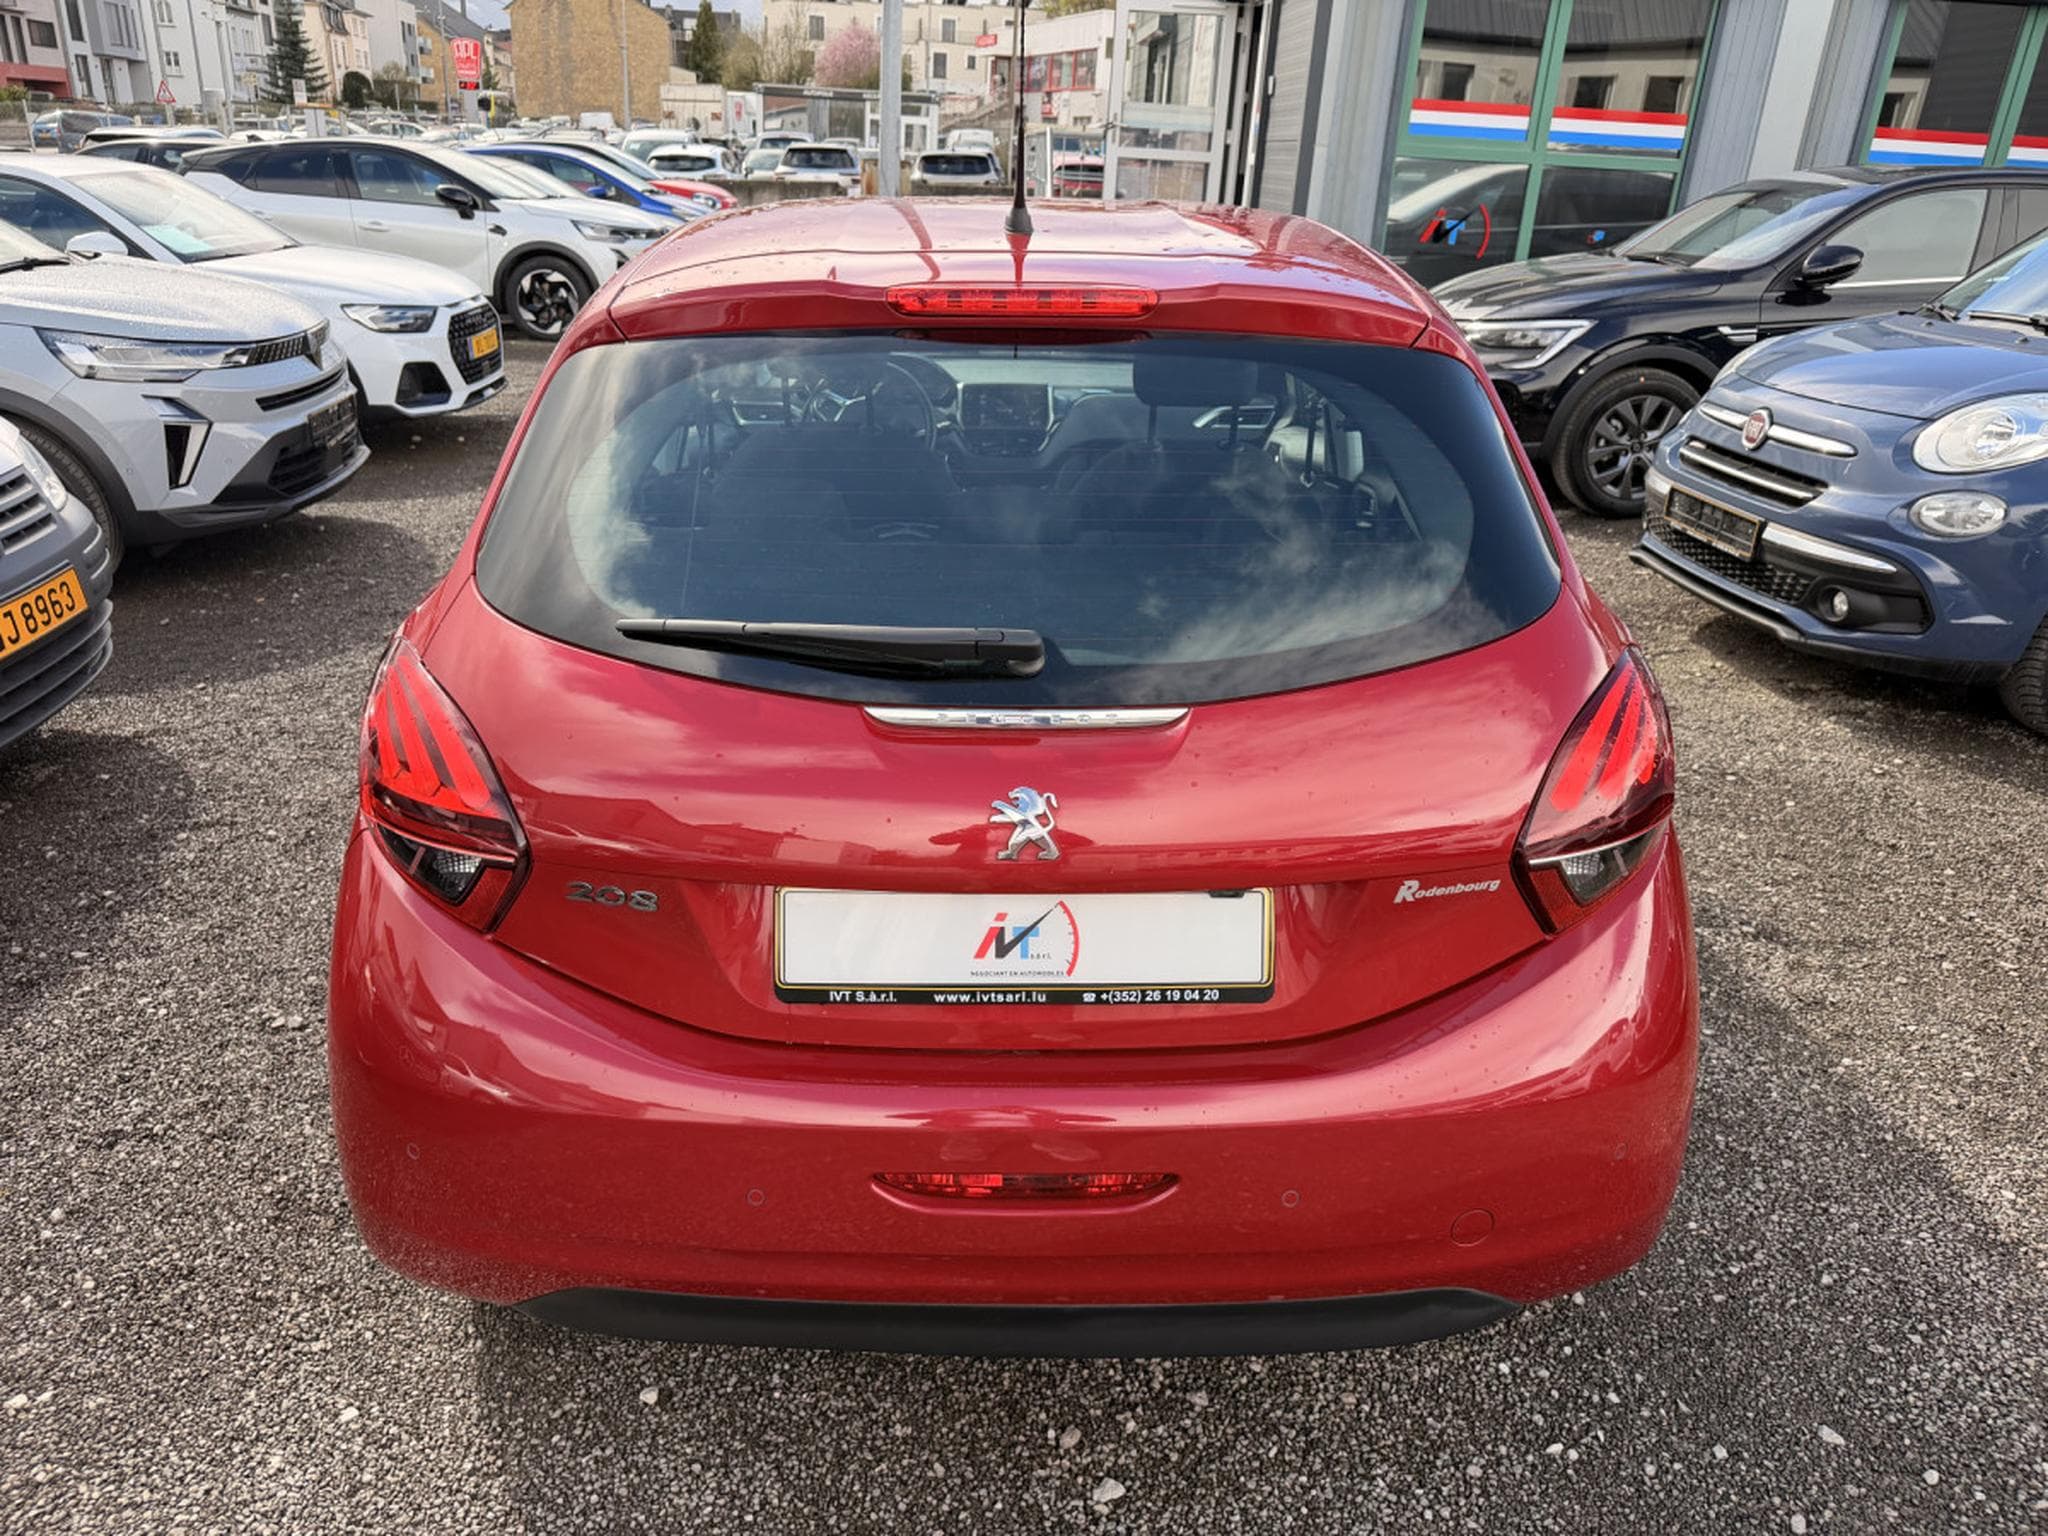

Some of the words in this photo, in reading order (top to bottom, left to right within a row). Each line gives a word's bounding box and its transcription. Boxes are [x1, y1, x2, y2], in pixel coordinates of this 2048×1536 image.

[565, 881, 658, 911] 208
[1393, 880, 1501, 904] Rodenbourg
[829, 990, 851, 1002] IVT
[933, 990, 1047, 1003] www.ivtsarl.lu
[1101, 989, 1142, 1004] +(352)
[1145, 990, 1161, 1001] 26
[1166, 990, 1178, 1001] 19
[1184, 990, 1199, 1001] 04
[1203, 989, 1219, 1001] 20
